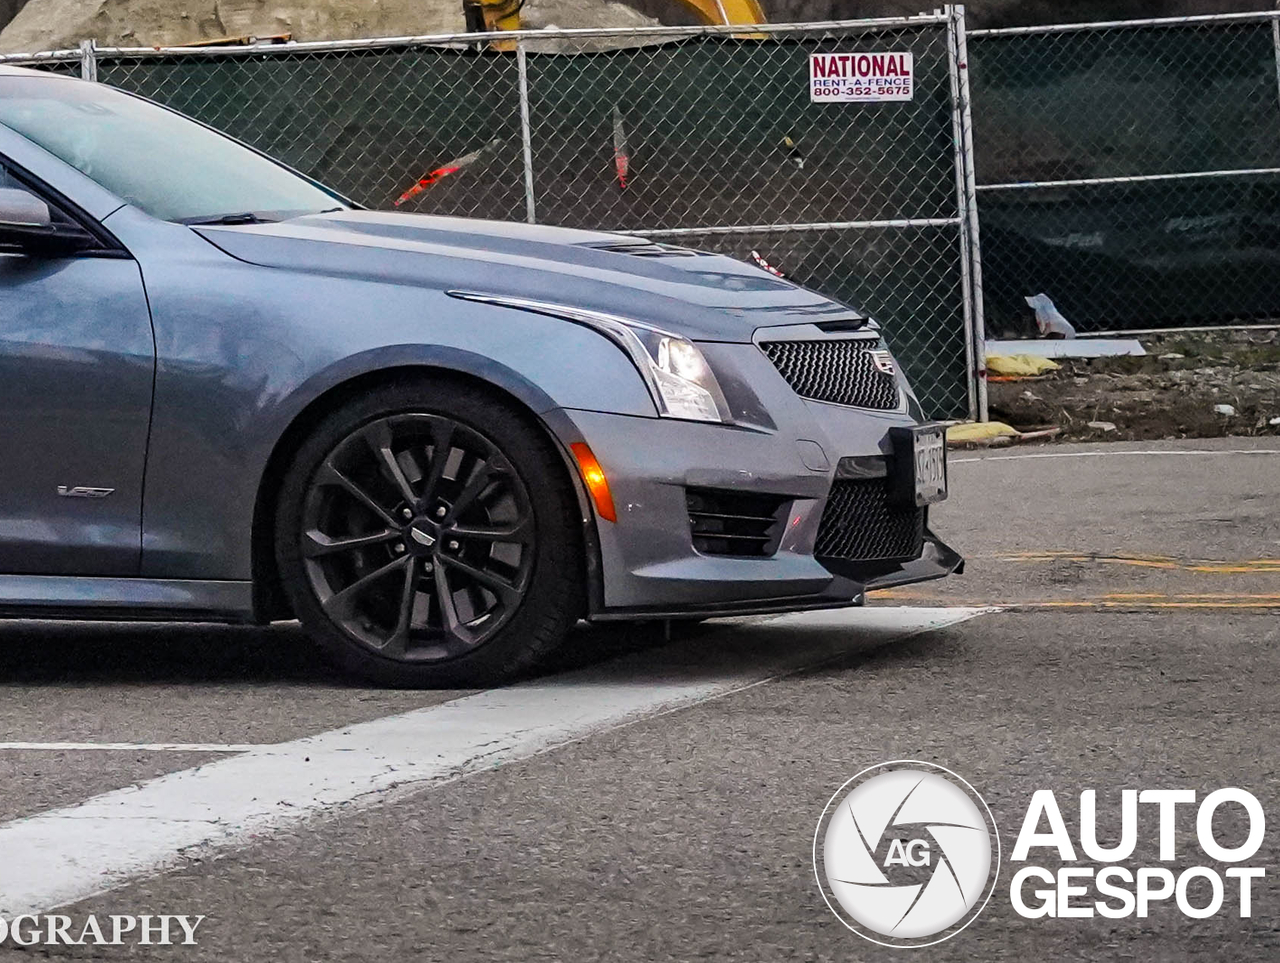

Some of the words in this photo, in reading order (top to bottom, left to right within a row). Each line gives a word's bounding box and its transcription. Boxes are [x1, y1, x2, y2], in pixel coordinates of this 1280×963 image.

[813, 55, 910, 78] NATIONAL
[813, 78, 910, 87] RENT-A-FENCE
[814, 87, 910, 96] 800-352-5675
